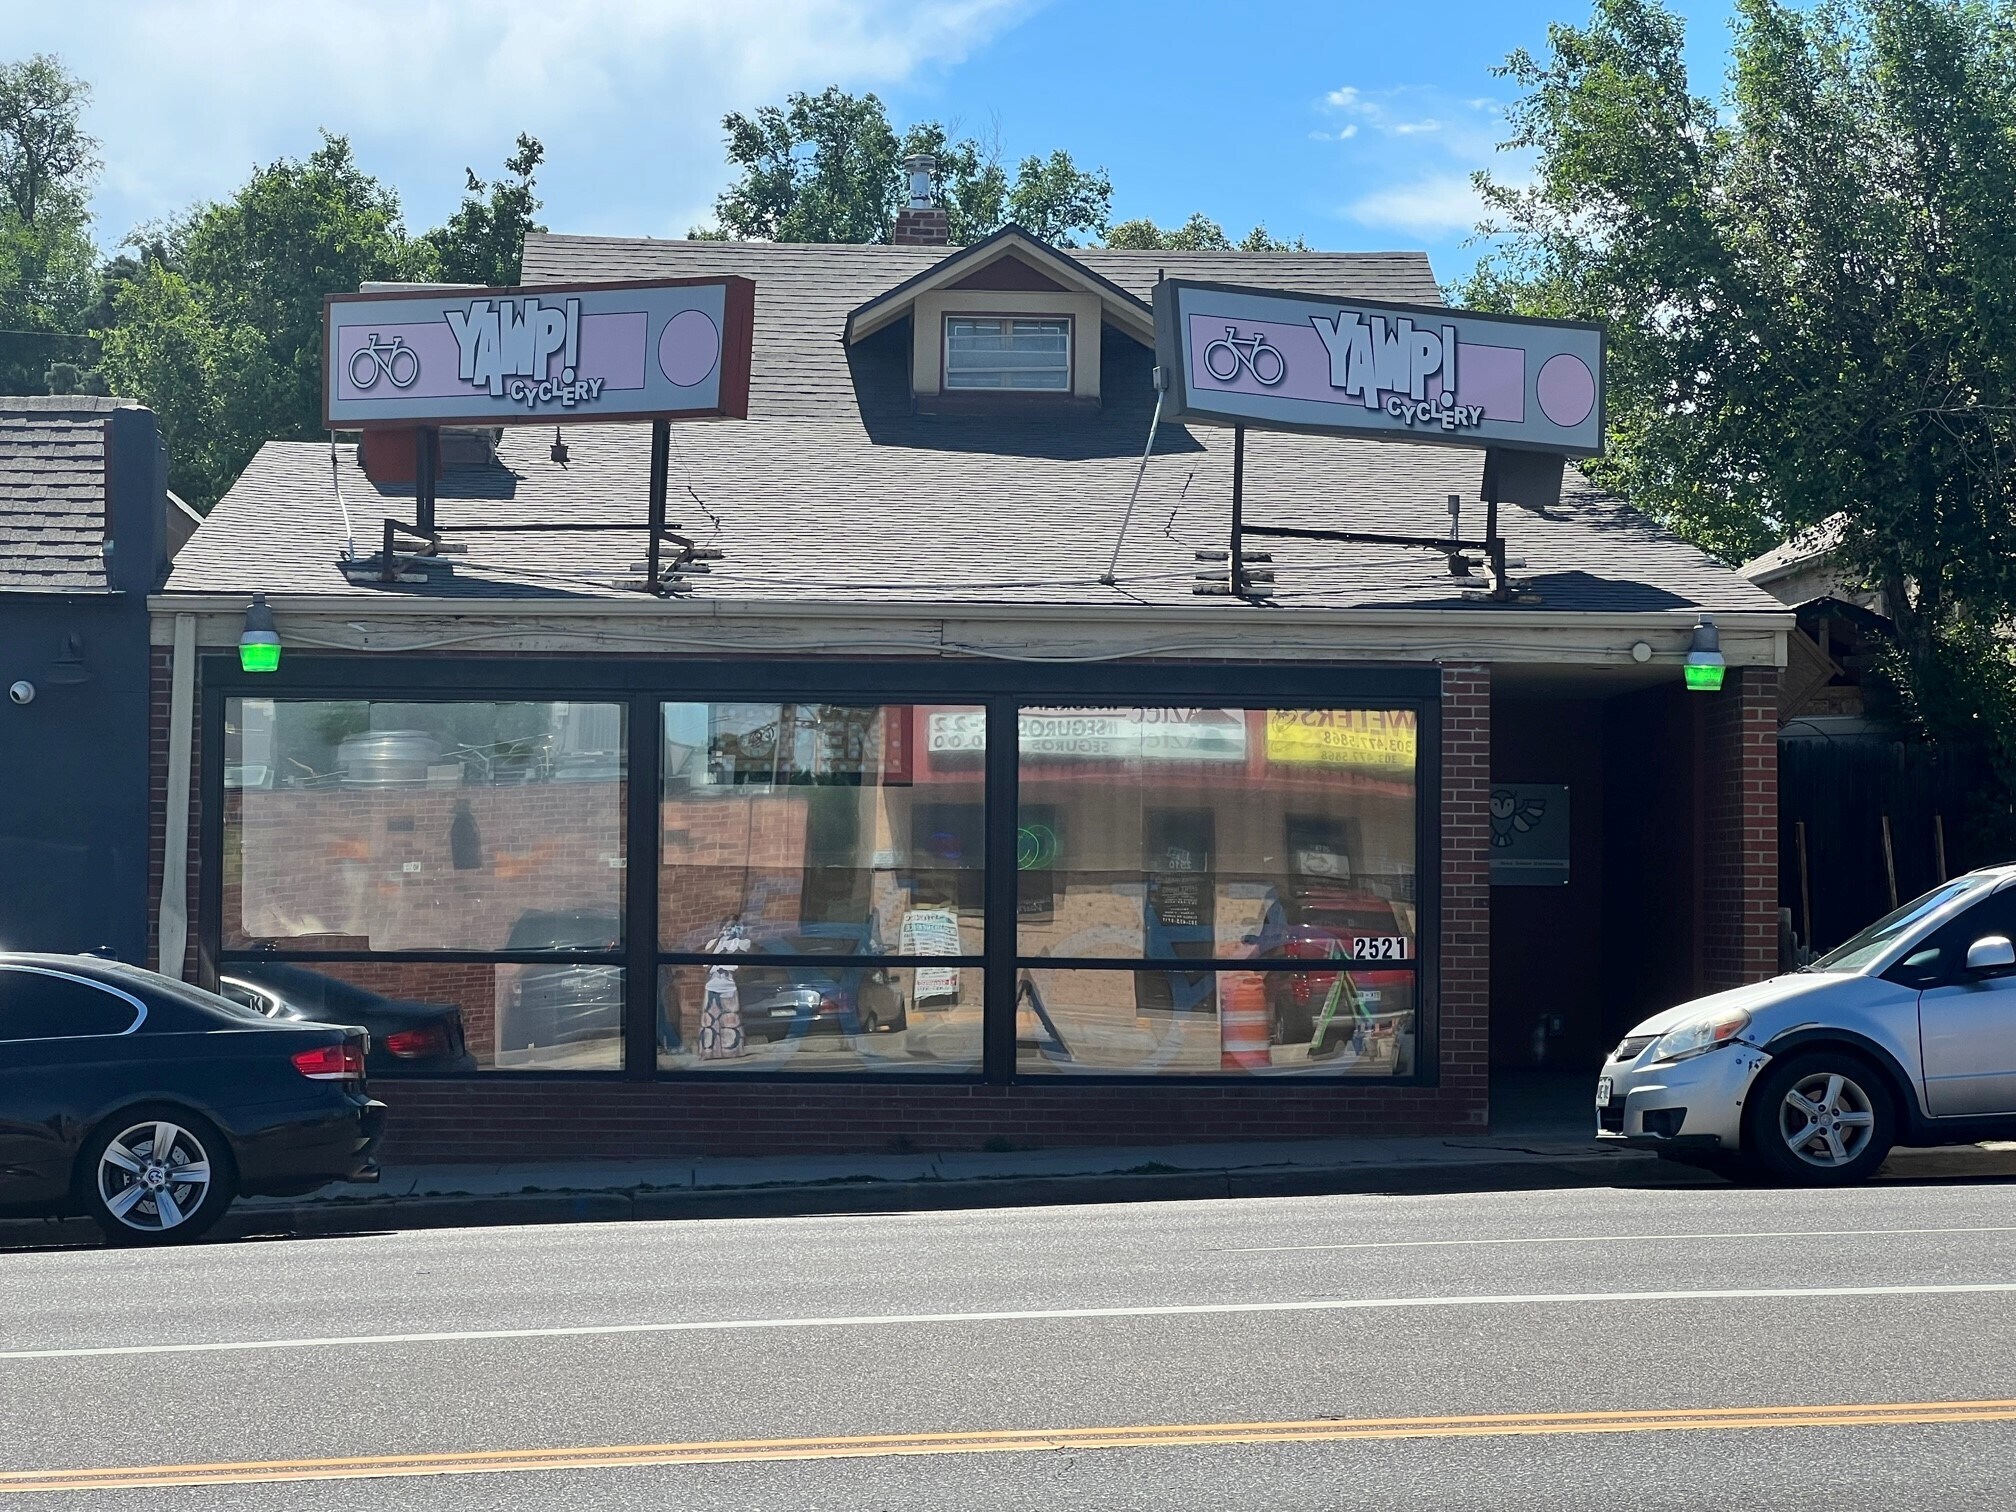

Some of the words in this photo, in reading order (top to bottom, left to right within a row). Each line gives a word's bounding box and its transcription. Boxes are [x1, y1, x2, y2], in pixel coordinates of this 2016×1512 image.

[444, 297, 581, 396] YAWP!
[1309, 310, 1456, 409] YAWP!
[510, 378, 603, 407] CYCLERY
[1386, 395, 1483, 430] CYCLERY
[1354, 937, 1405, 960] 2521
